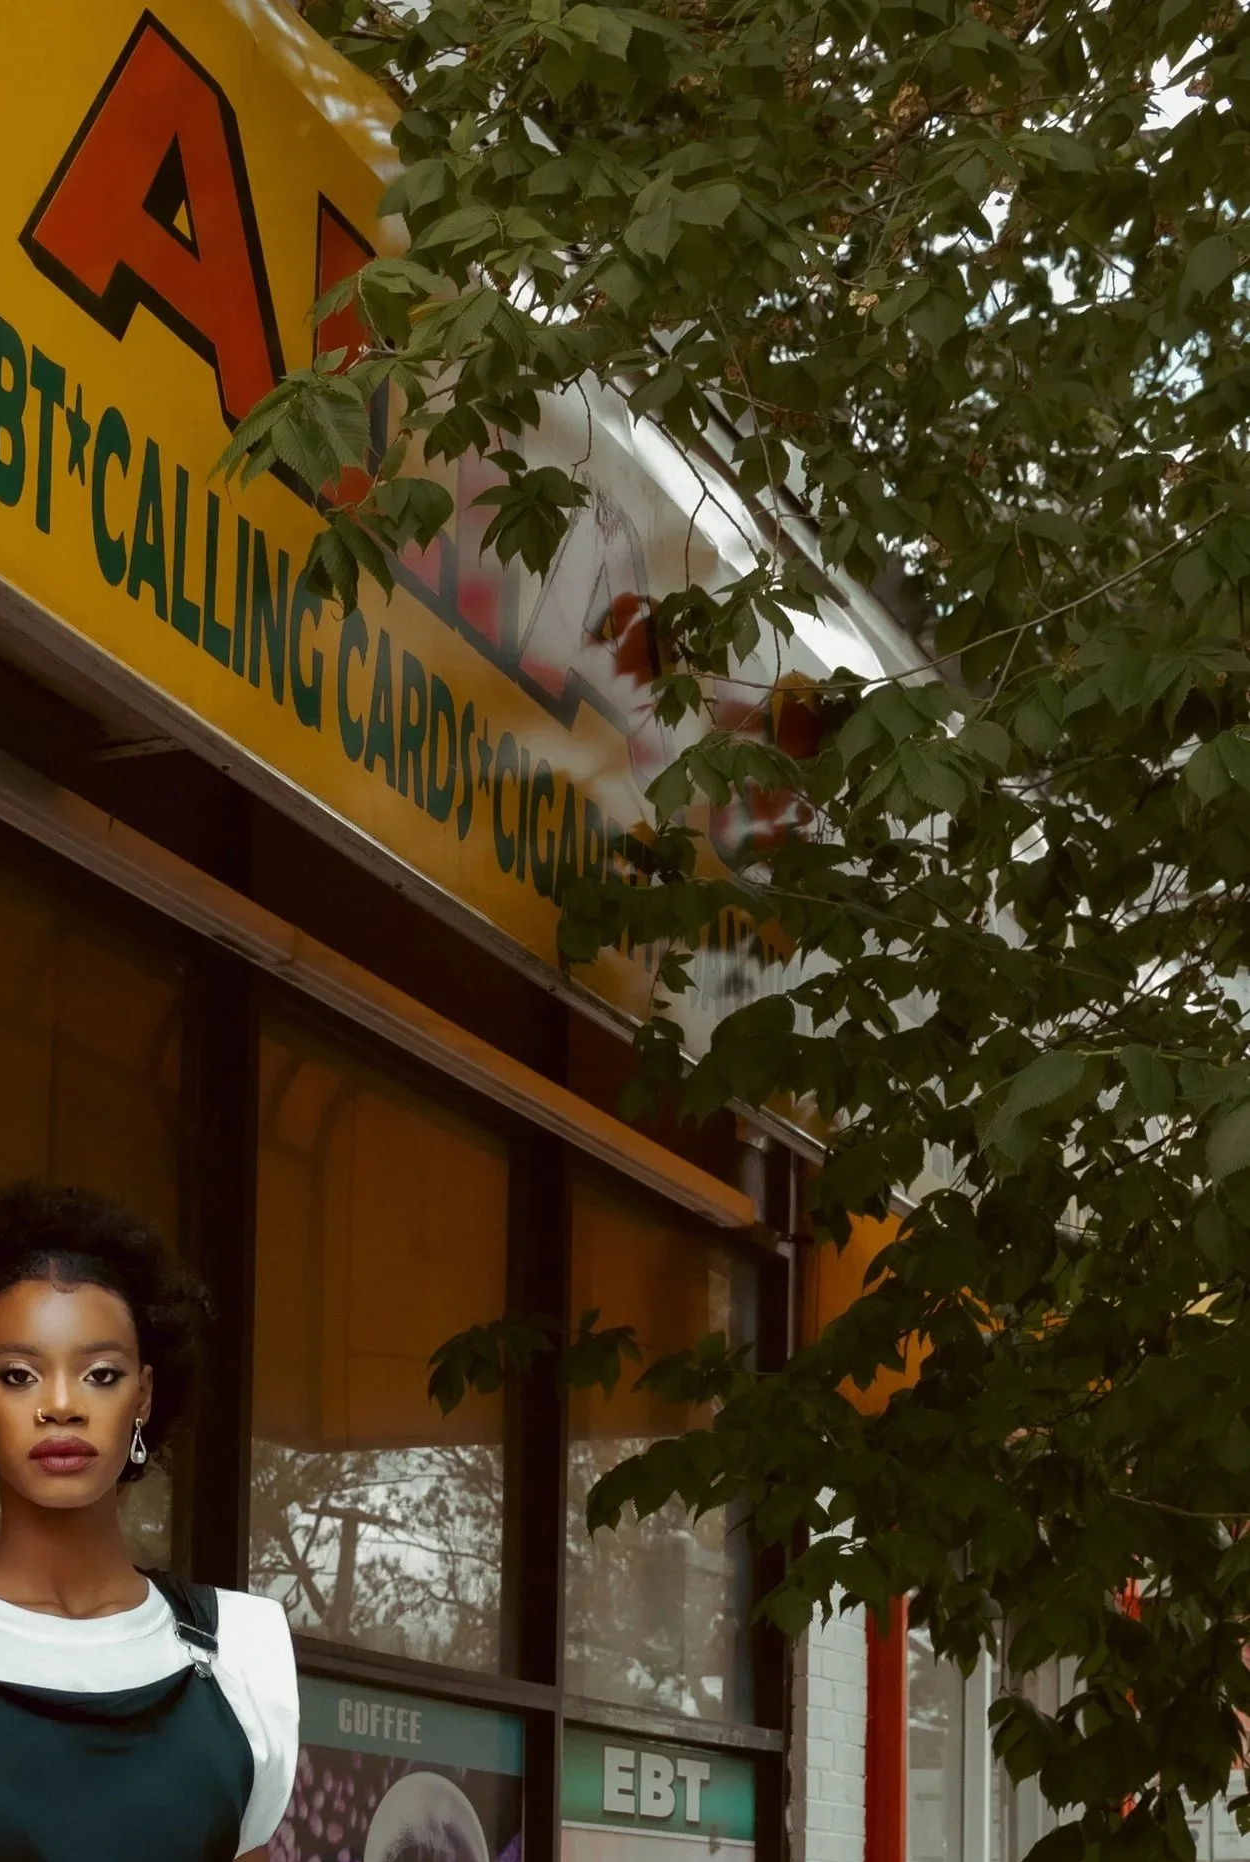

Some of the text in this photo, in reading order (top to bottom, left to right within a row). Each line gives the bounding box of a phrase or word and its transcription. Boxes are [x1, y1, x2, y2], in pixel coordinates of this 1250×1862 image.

[91, 405, 324, 733] CALLING
[336, 617, 475, 839] CARDS
[338, 1697, 422, 1745] COFFEE
[603, 1746, 710, 1822] EBT
